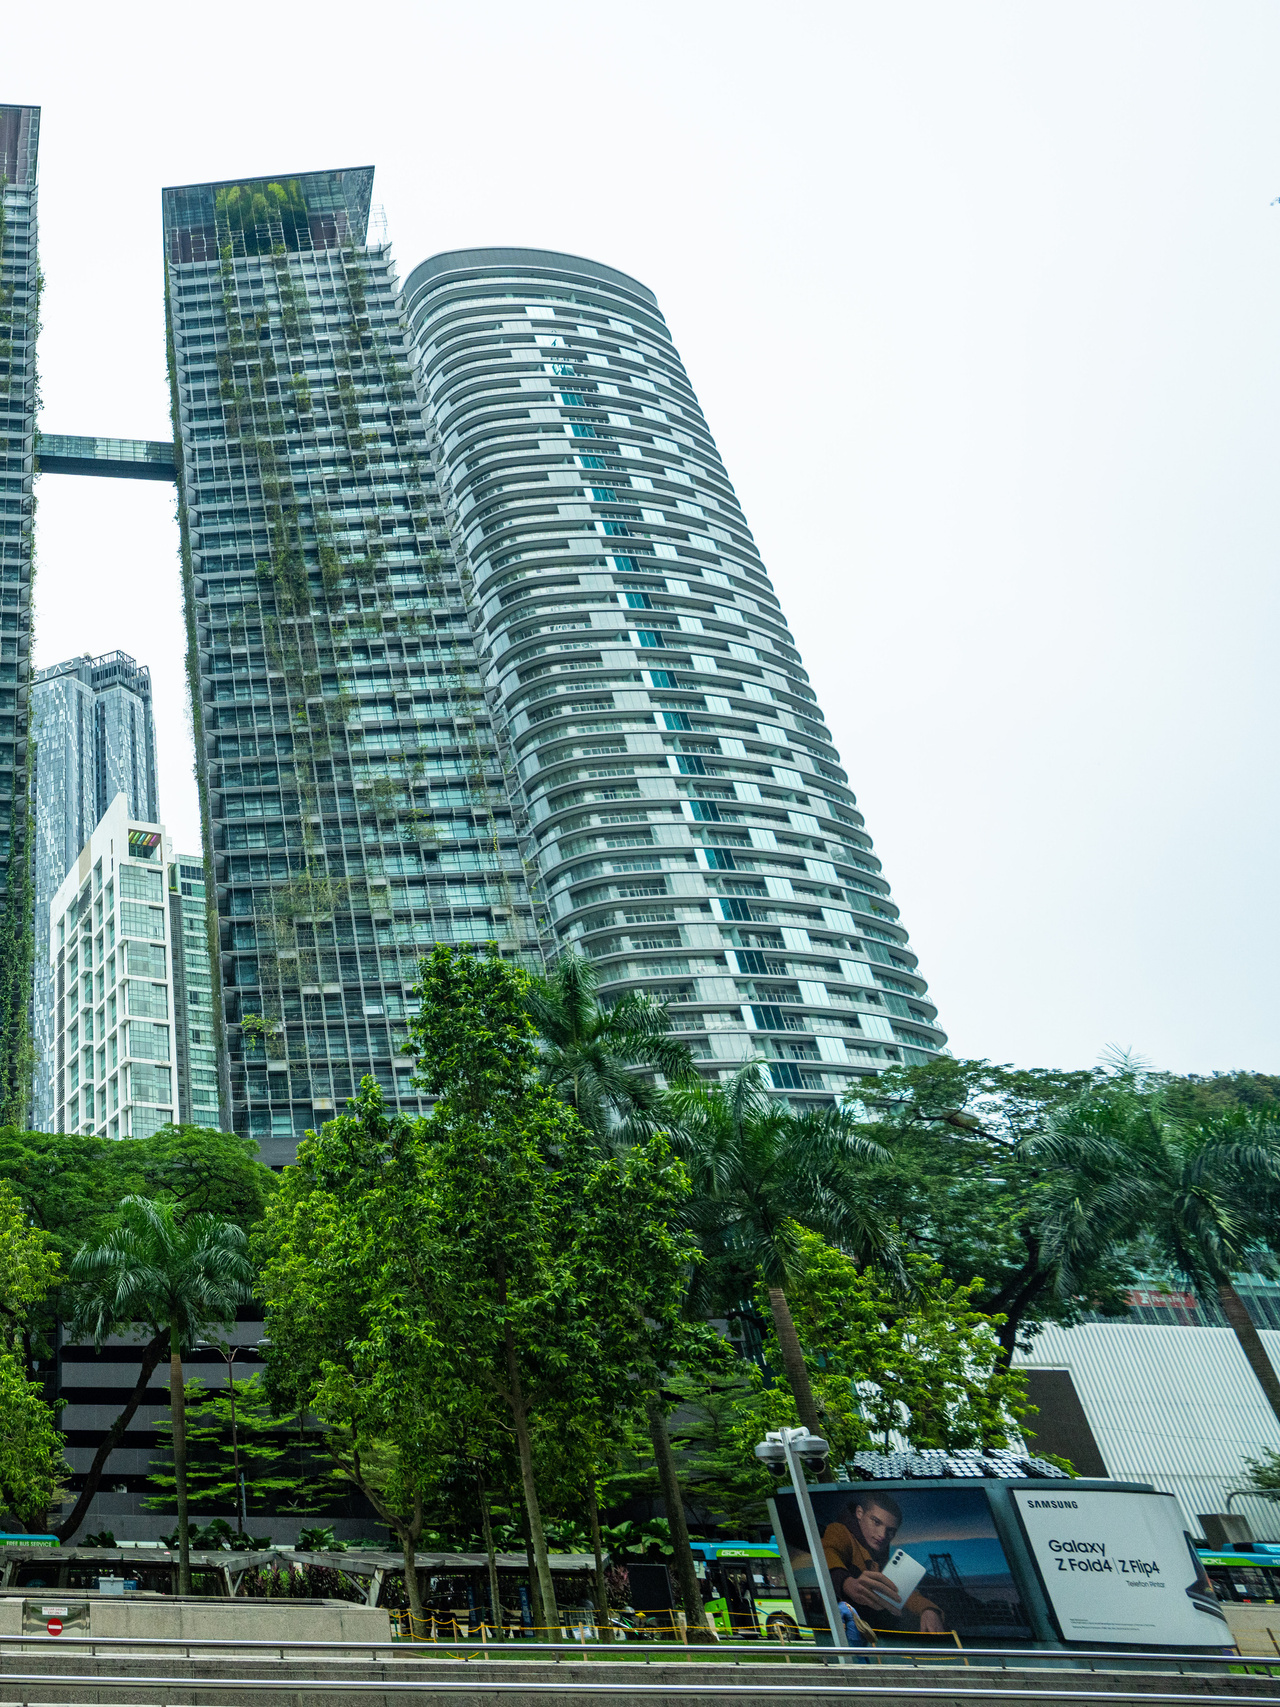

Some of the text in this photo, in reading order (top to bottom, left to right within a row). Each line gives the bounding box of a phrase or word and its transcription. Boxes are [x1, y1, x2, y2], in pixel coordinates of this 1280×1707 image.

[1027, 1500, 1079, 1509] SAMSUNG
[721, 1549, 750, 1557] GOKL
[1048, 1539, 1106, 1557] Galaxy
[1054, 1558, 1160, 1578] Z Fold4 Z Flip4
